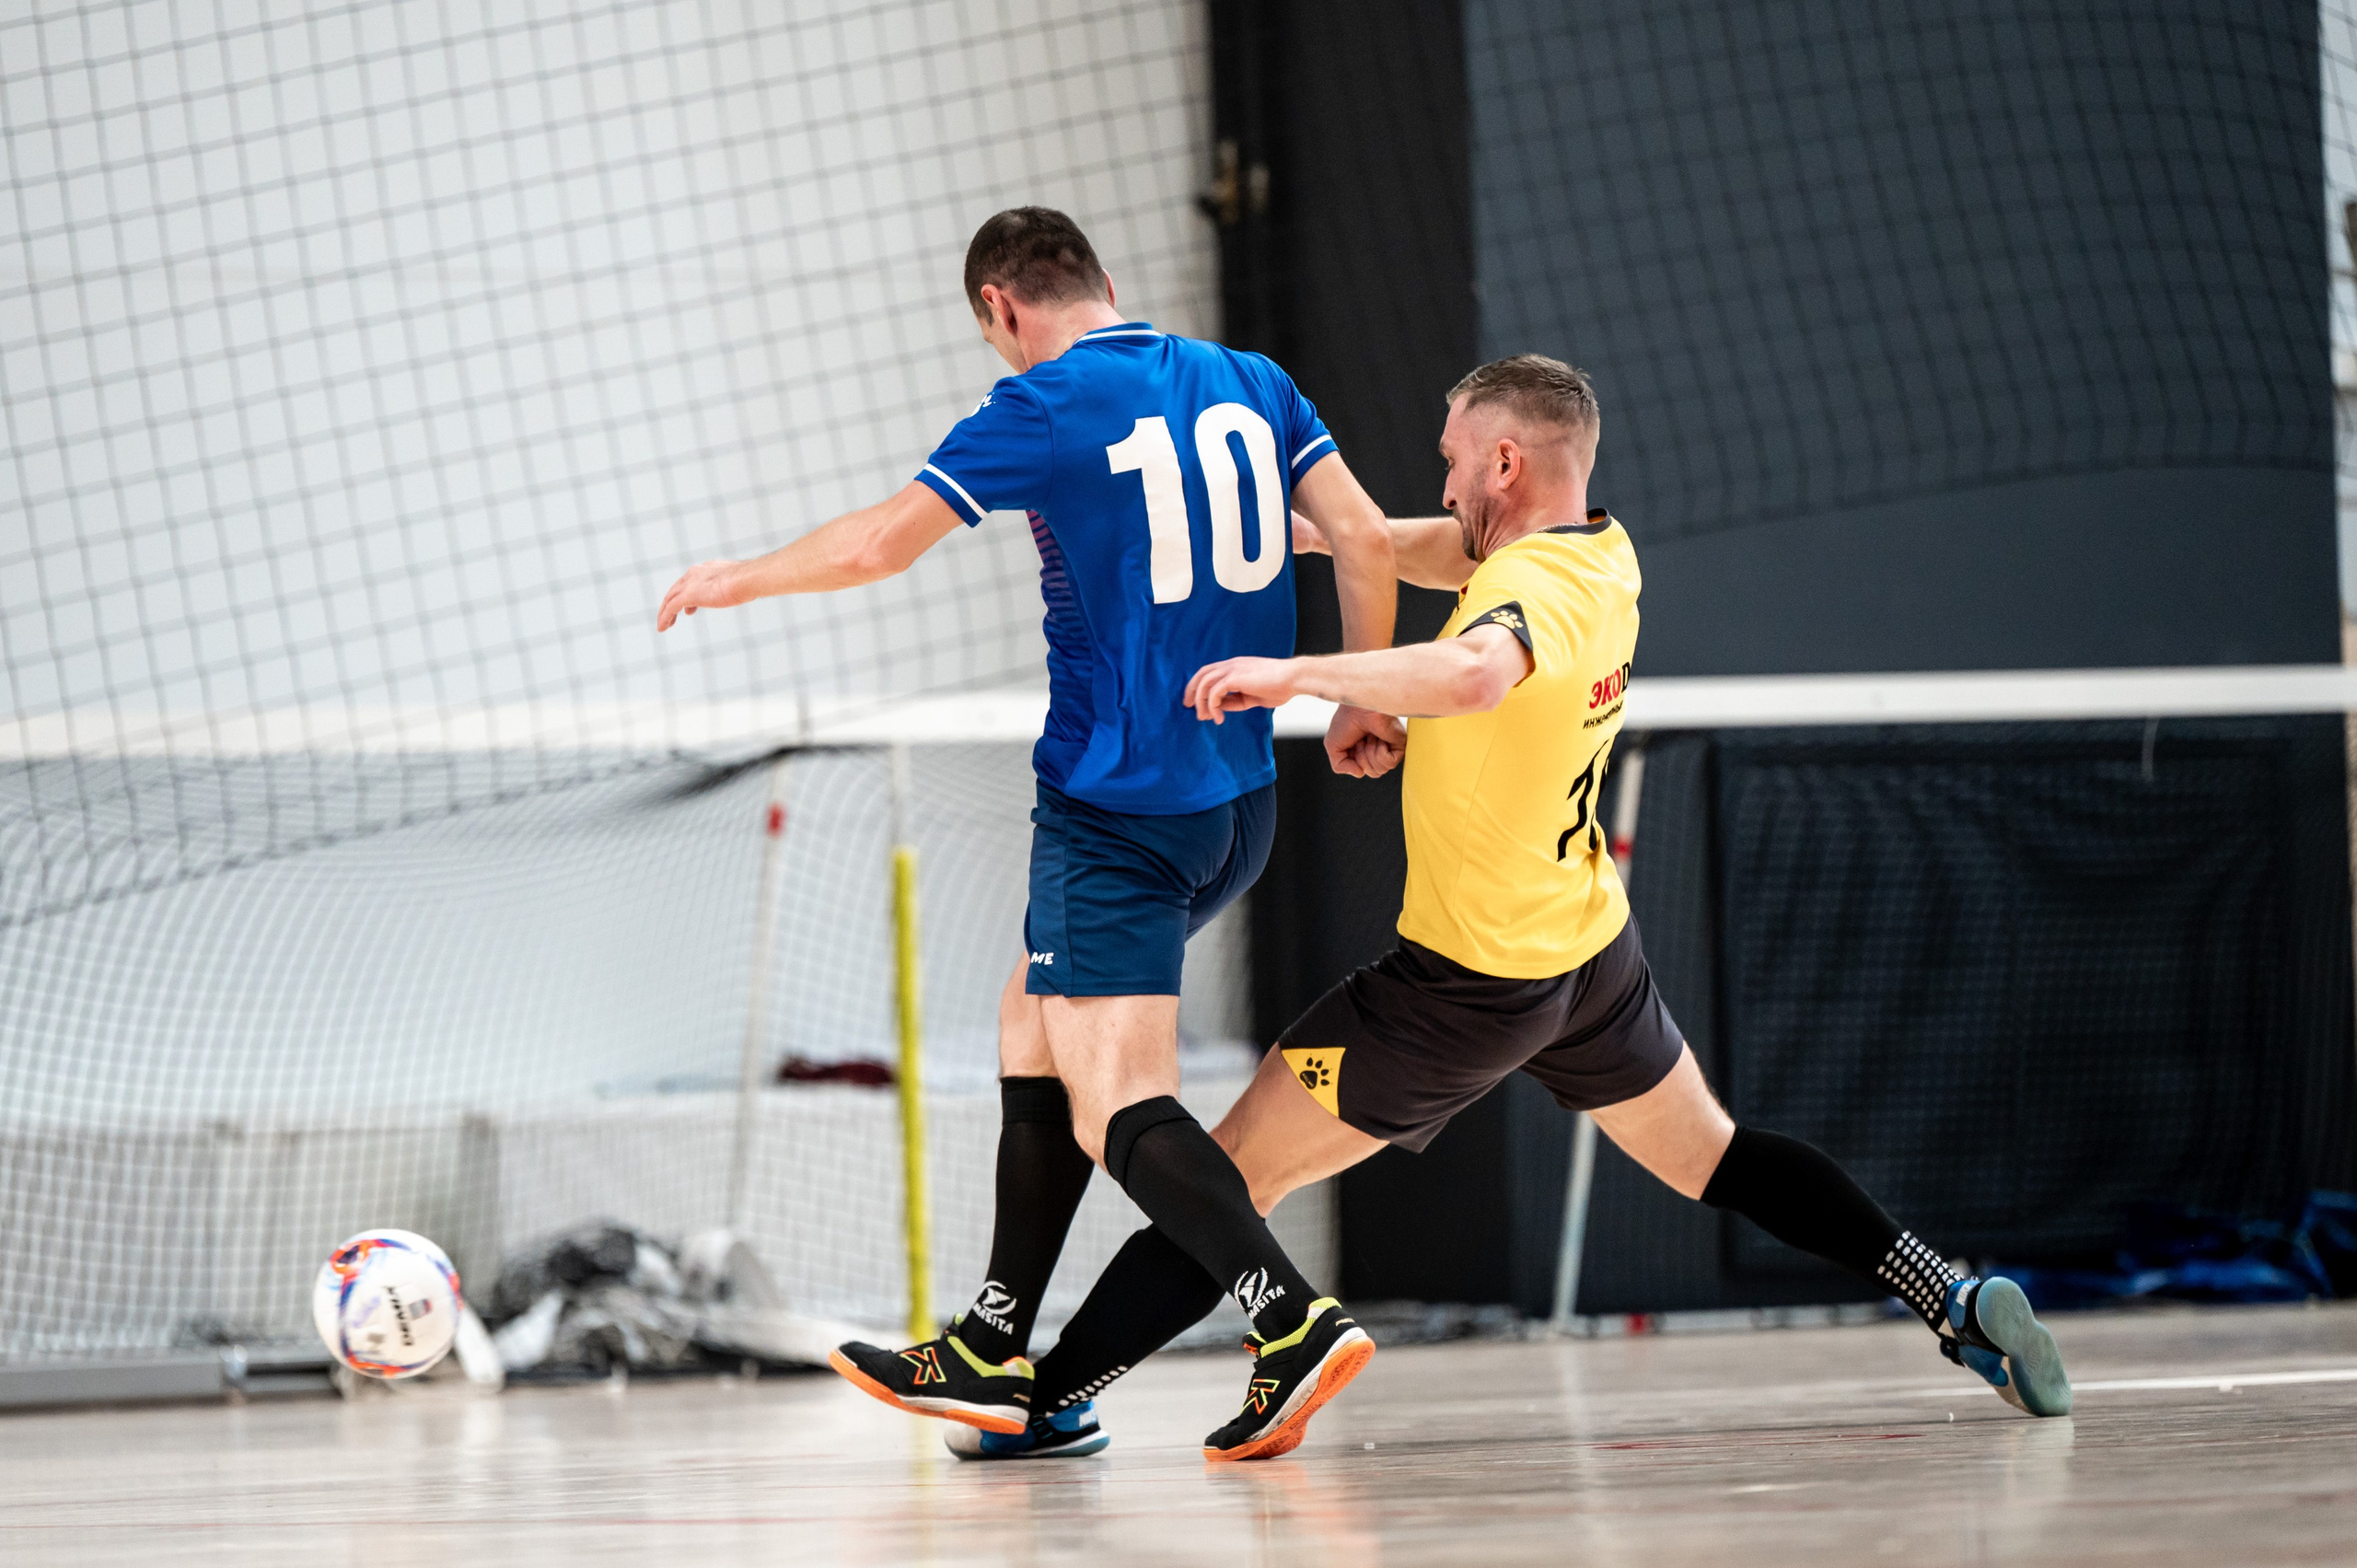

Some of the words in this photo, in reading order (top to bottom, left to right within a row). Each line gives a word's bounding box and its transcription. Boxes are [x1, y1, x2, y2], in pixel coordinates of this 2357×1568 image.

[1106, 402, 1285, 604] 10
[1030, 951, 1054, 965] ME
[972, 1302, 1014, 1335] MASITA
[1248, 1285, 1286, 1321] MASITA
